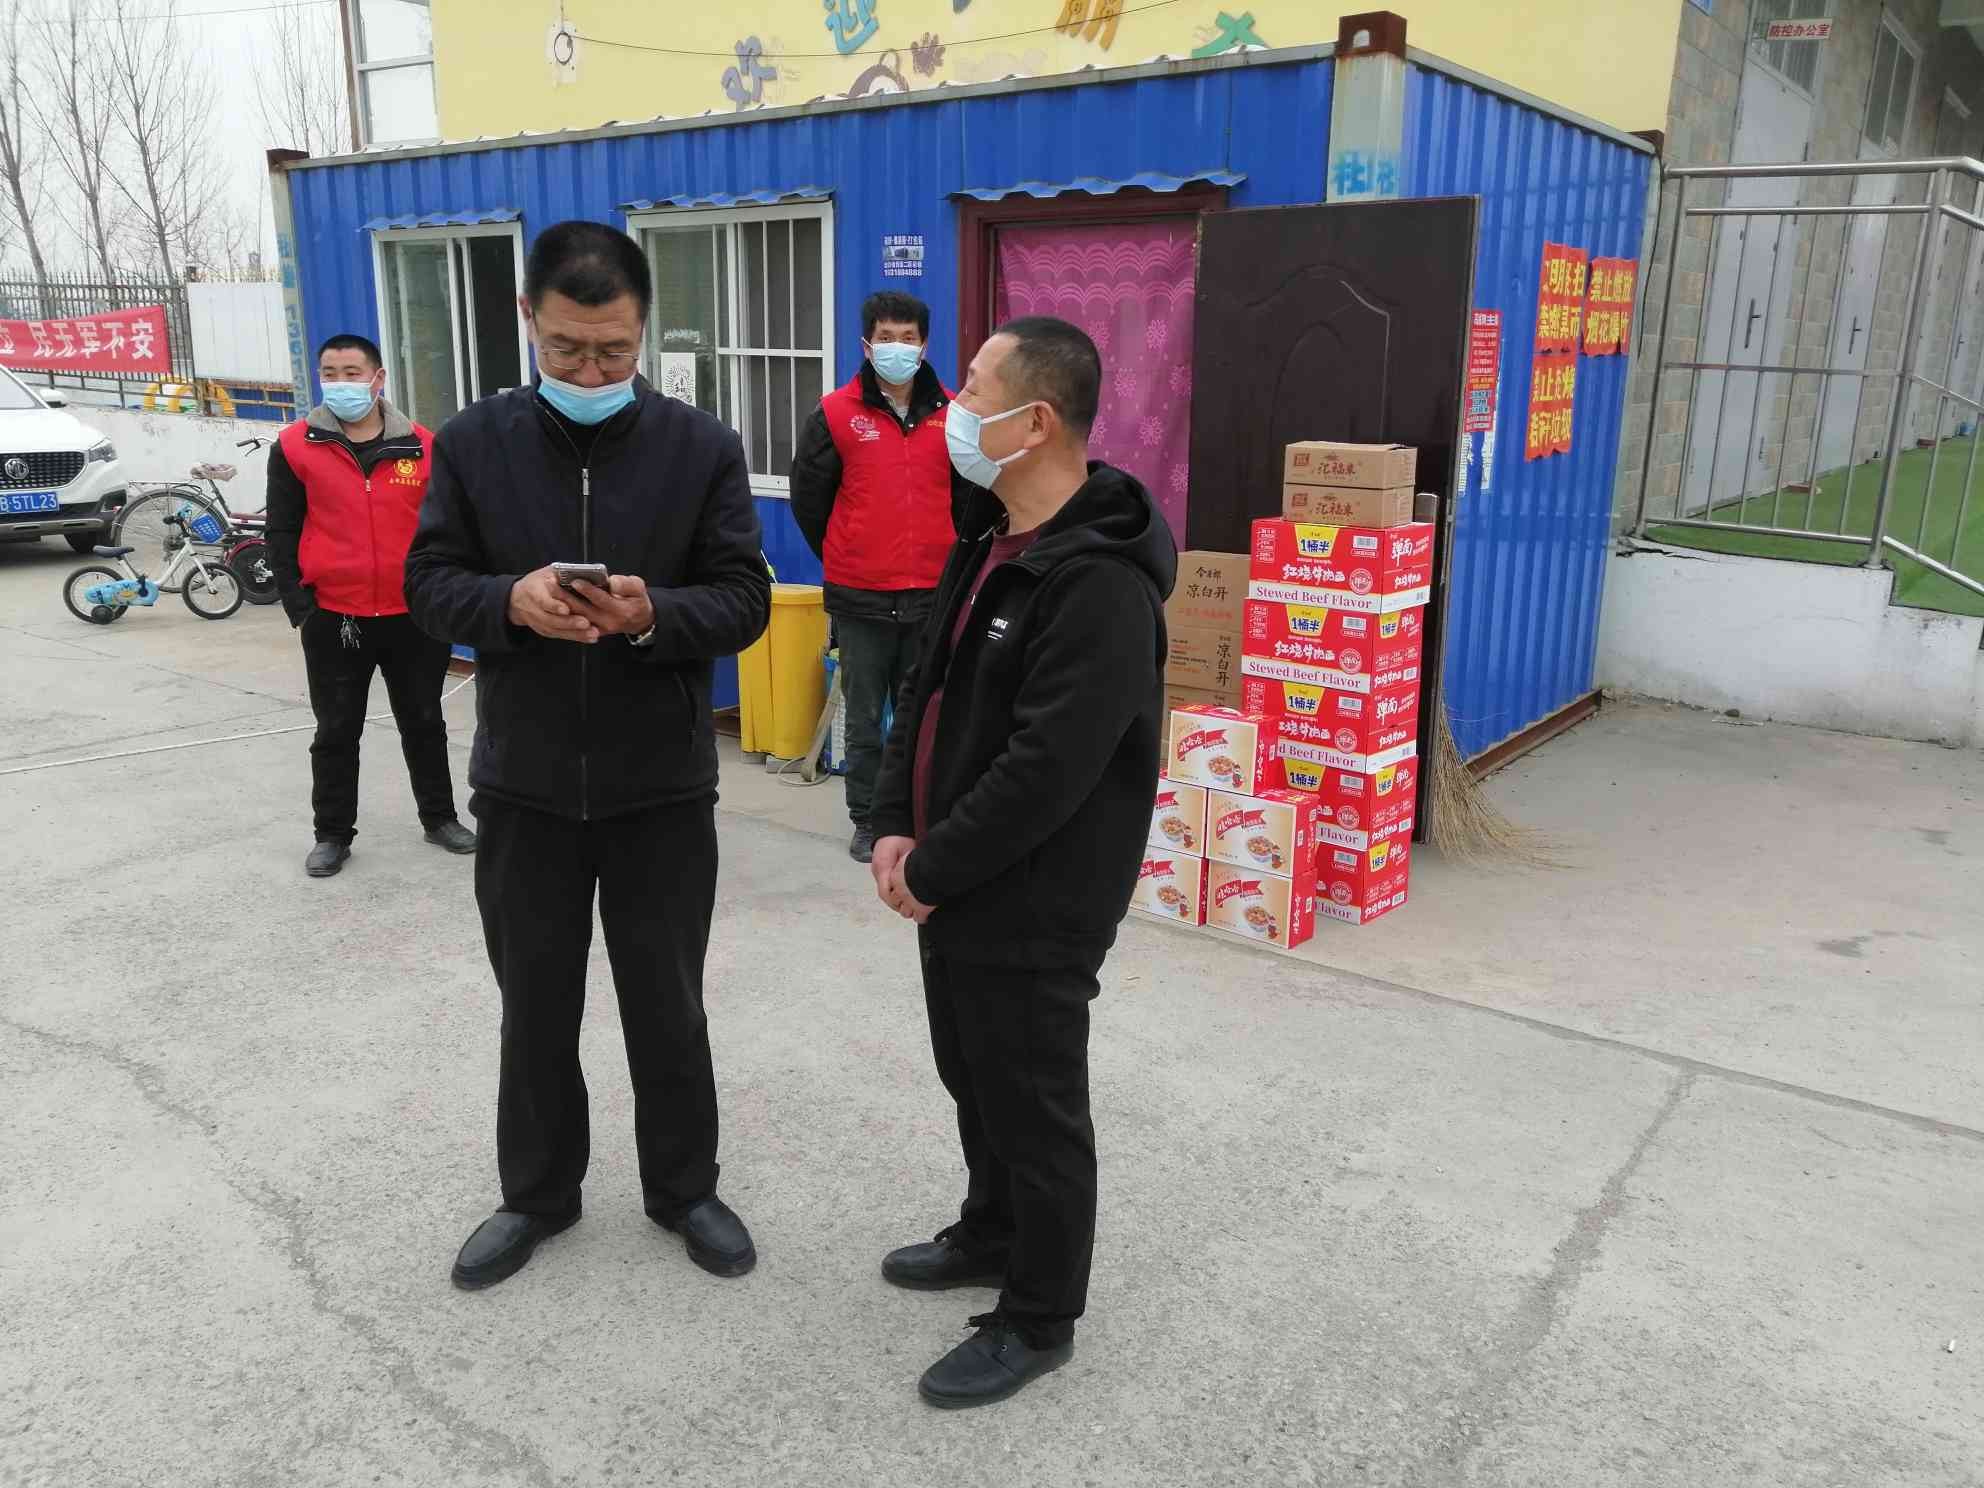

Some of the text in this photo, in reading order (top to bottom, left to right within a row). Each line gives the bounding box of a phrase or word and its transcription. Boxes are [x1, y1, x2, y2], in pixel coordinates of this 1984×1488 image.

[1769, 23, 1830, 37] 防控办公室
[27, 319, 154, 360] 民无军不安
[1300, 538, 1330, 553] 1桶半
[1282, 563, 1345, 585] 红烧牛肉面
[1186, 584, 1228, 601] 凉白开
[1256, 586, 1372, 609] Stewed Beef Flavor
[1291, 616, 1320, 632] 1桶半
[1274, 640, 1335, 662] 红烧牛肉面
[1216, 643, 1232, 687] 凉白开
[1249, 661, 1361, 688] Stewed Beef Flavor
[1288, 695, 1316, 711] 1桶半
[1289, 746, 1317, 759] Beef
[1320, 751, 1357, 768] Flavor
[1290, 772, 1318, 788] 1桶半
[1320, 827, 1360, 844] Flavor
